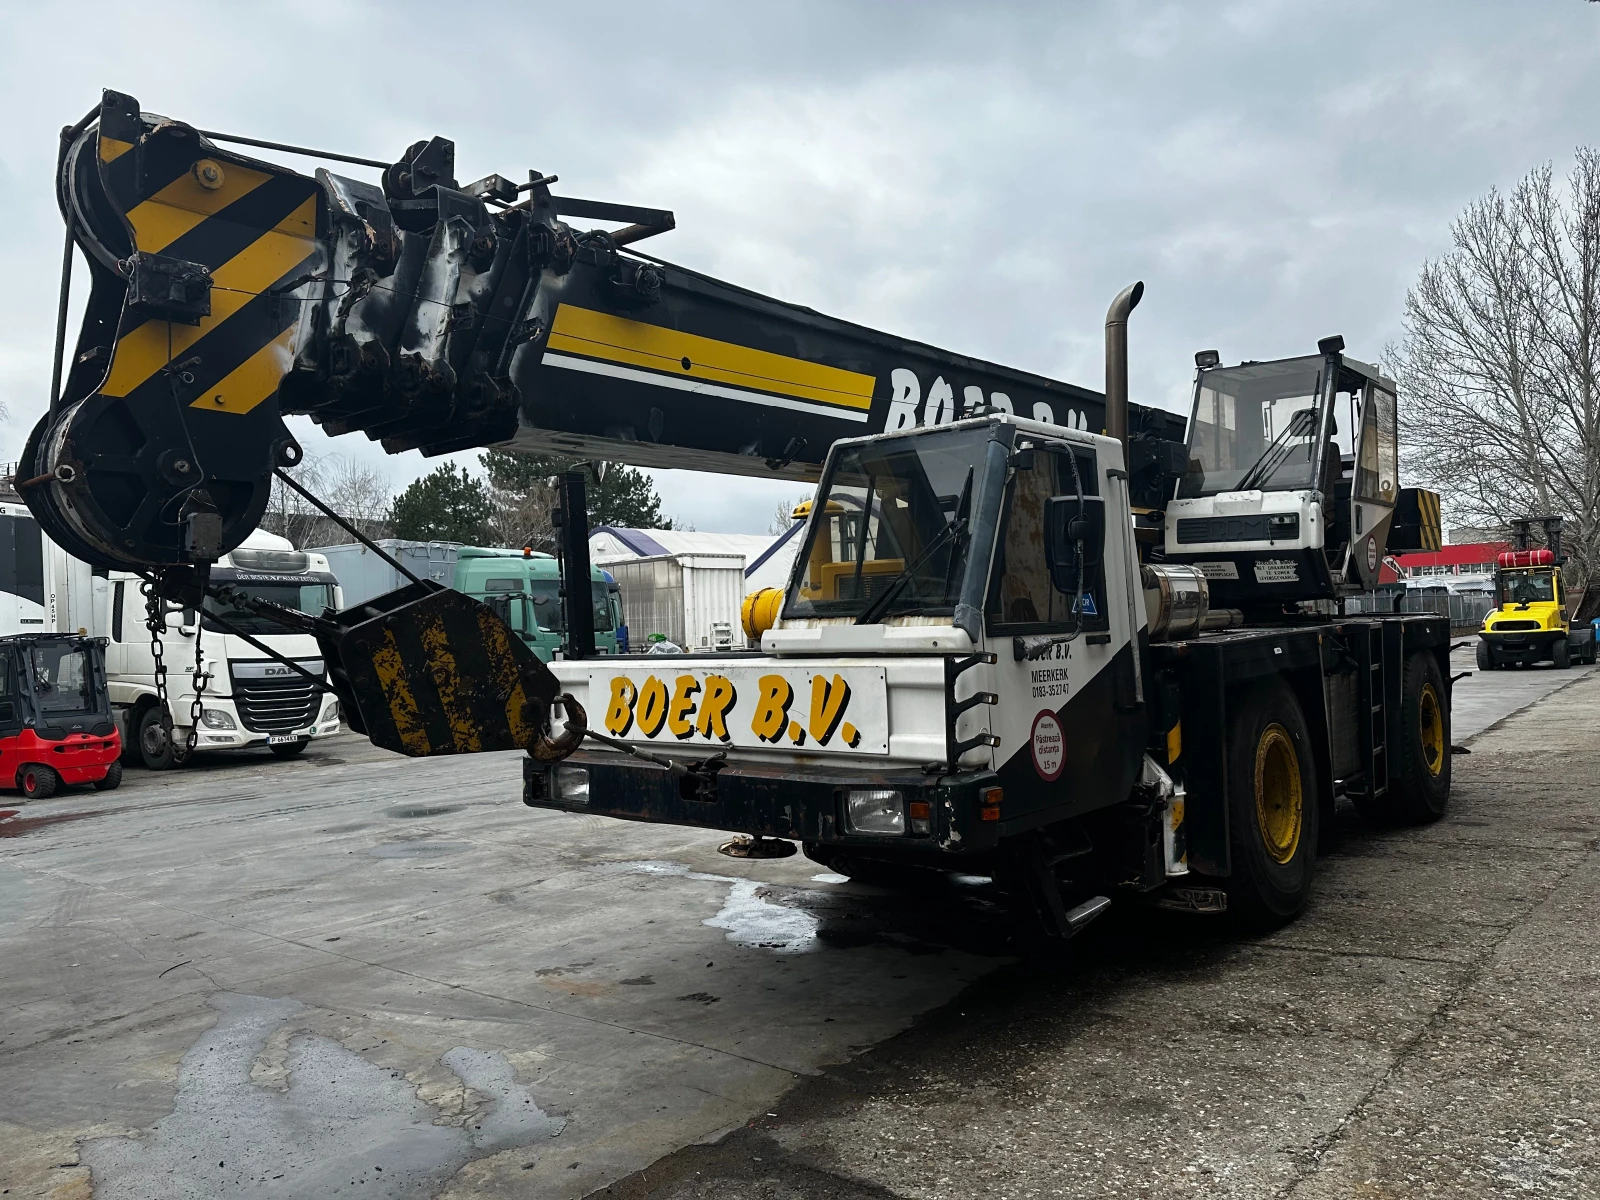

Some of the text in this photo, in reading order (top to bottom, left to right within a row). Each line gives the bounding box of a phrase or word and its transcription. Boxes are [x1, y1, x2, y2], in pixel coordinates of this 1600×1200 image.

[1056, 643, 1072, 660] B.V.
[1031, 668, 1069, 683] MEERKERK
[605, 673, 862, 749] BOER B.V.
[1043, 760, 1051, 770] 15
